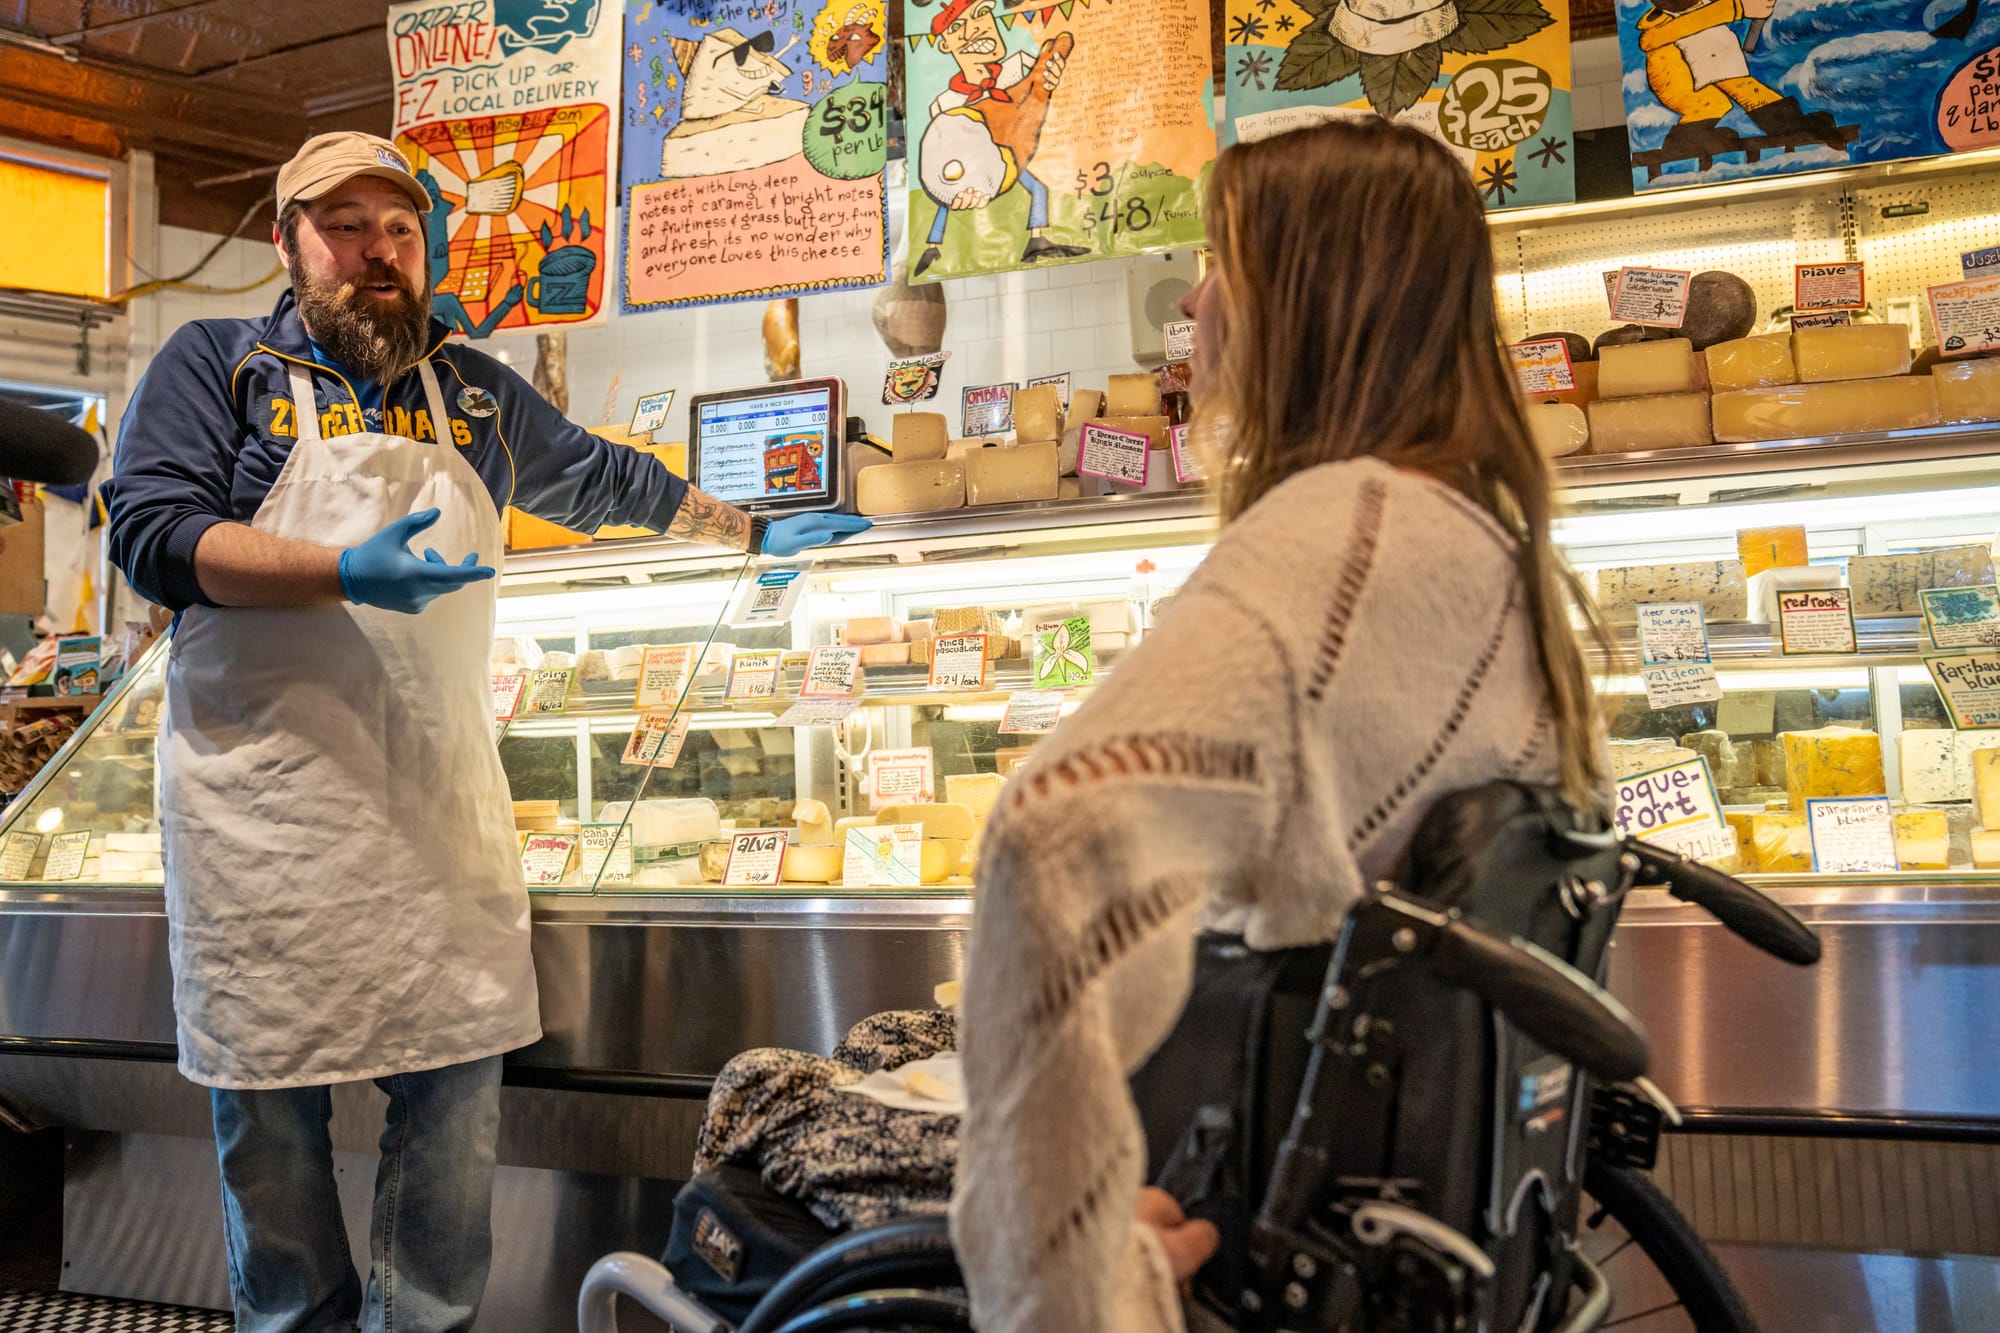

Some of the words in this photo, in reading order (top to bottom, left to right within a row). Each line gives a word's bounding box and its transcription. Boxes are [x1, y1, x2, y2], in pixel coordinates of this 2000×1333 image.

[394, 1, 487, 38] ORDER
[718, 6, 742, 21] the
[396, 22, 498, 79] ONLINE!
[453, 70, 498, 93] PICK
[510, 65, 535, 86] UP
[443, 93, 504, 114] LOCAL
[514, 80, 599, 104] DELIVERY
[1446, 66, 1550, 144] $25
[1469, 114, 1541, 149] each
[832, 141, 863, 166] per
[696, 182, 725, 196] with
[763, 175, 798, 191] deep
[639, 204, 676, 221] notes
[680, 201, 694, 214] of
[782, 185, 833, 214] bright
[838, 189, 873, 202] notes
[641, 223, 656, 236] of
[661, 215, 727, 234] fruitiness
[641, 239, 667, 259] and
[671, 235, 717, 252] fresh
[750, 231, 768, 243] no
[774, 228, 840, 242] wonder
[845, 225, 872, 241] why
[646, 254, 716, 280] everyone
[770, 244, 799, 262] this
[710, 424, 727, 433] 0.000
[739, 421, 755, 430] 0.000
[776, 417, 789, 426] 0.00
[812, 413, 826, 422] 0.00
[1642, 609, 1664, 617] deer
[1784, 594, 1809, 609] red
[1811, 597, 1840, 608] rock
[1036, 624, 1059, 632] trillium
[939, 638, 964, 647] finca
[936, 673, 957, 685] $24
[1620, 769, 1700, 810] oque-
[1614, 791, 1697, 832] fort
